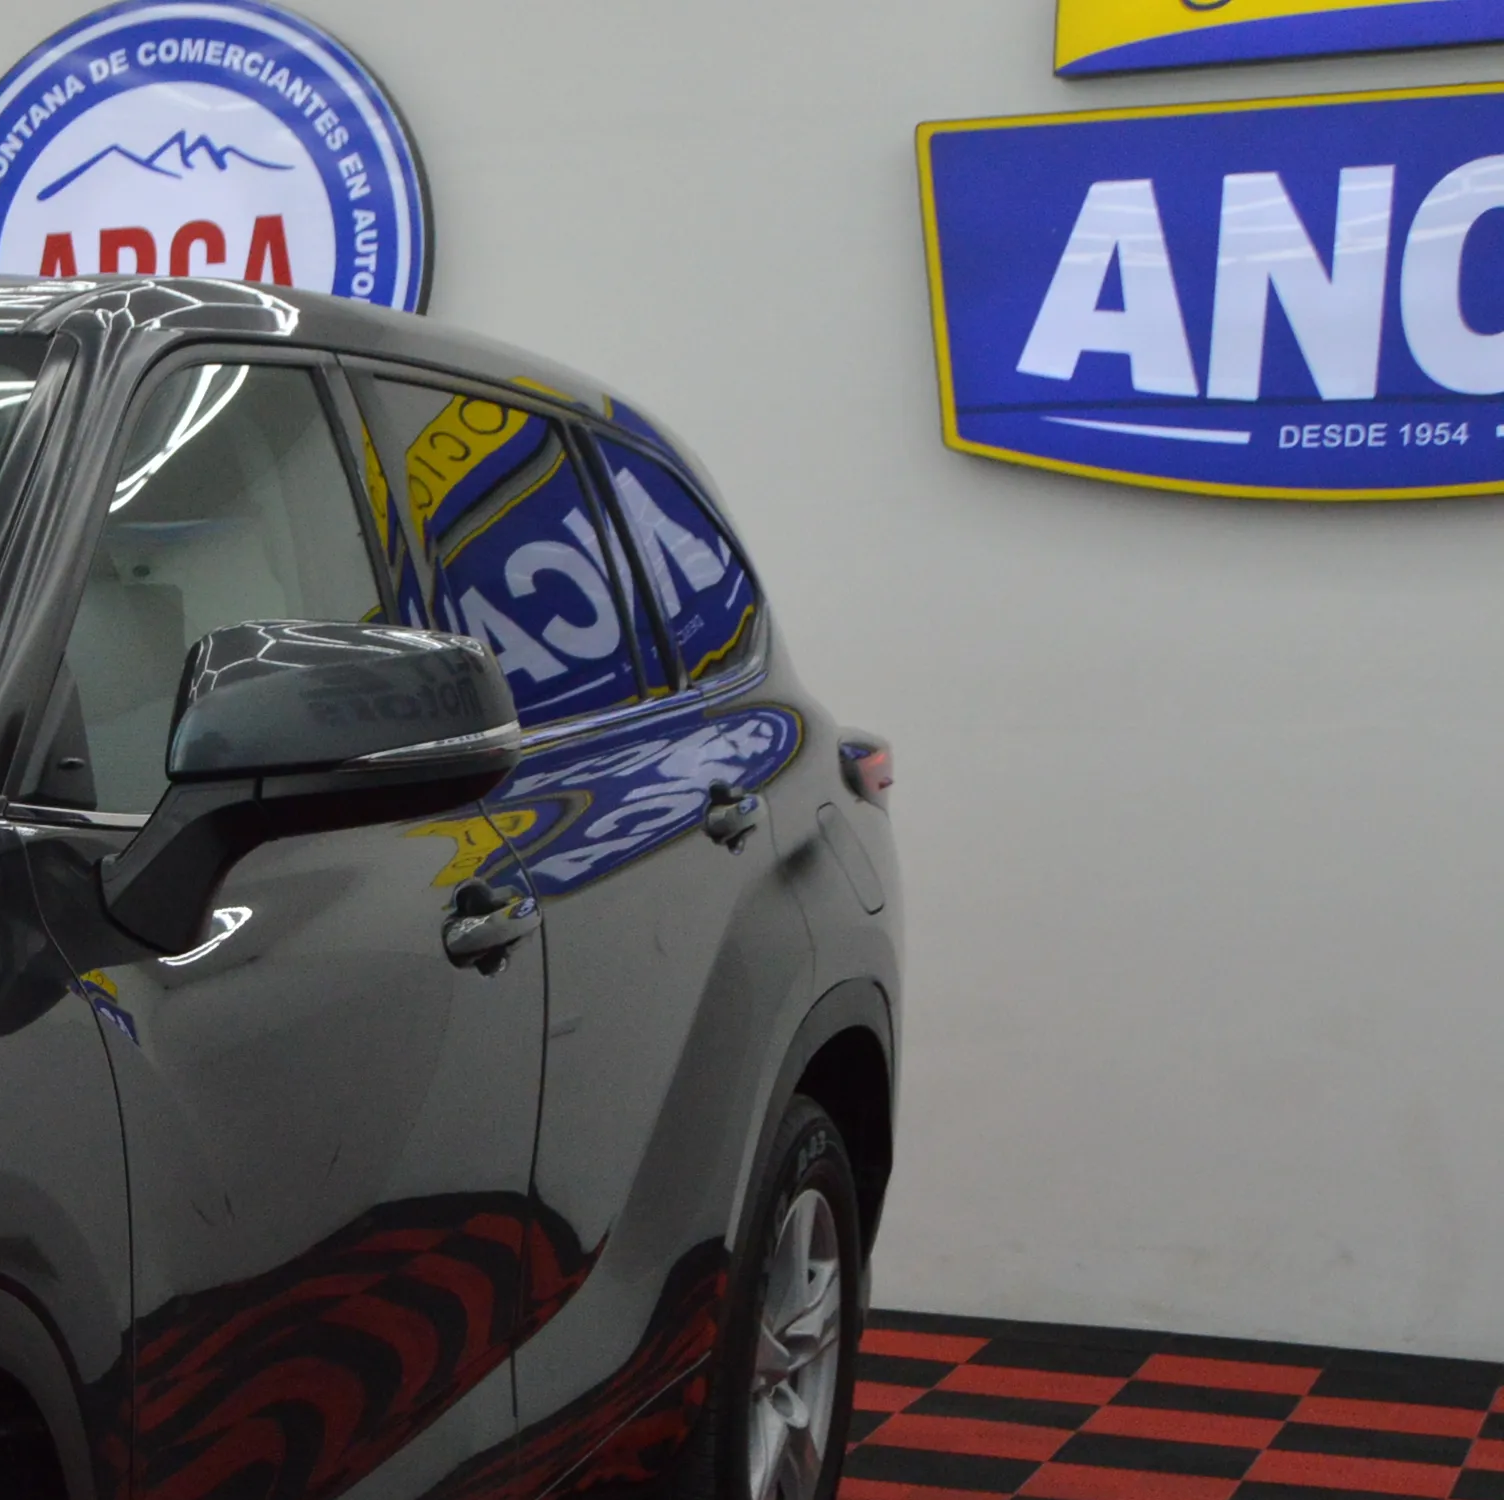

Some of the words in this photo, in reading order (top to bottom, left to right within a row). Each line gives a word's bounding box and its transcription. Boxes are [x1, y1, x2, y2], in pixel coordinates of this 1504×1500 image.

[88, 49, 129, 85] DE
[137, 37, 349, 151] COMERCIANTES
[338, 152, 372, 201] EN
[350, 209, 378, 303] AUTO
[1278, 423, 1388, 449] DESDE
[1399, 422, 1470, 446] 1954
